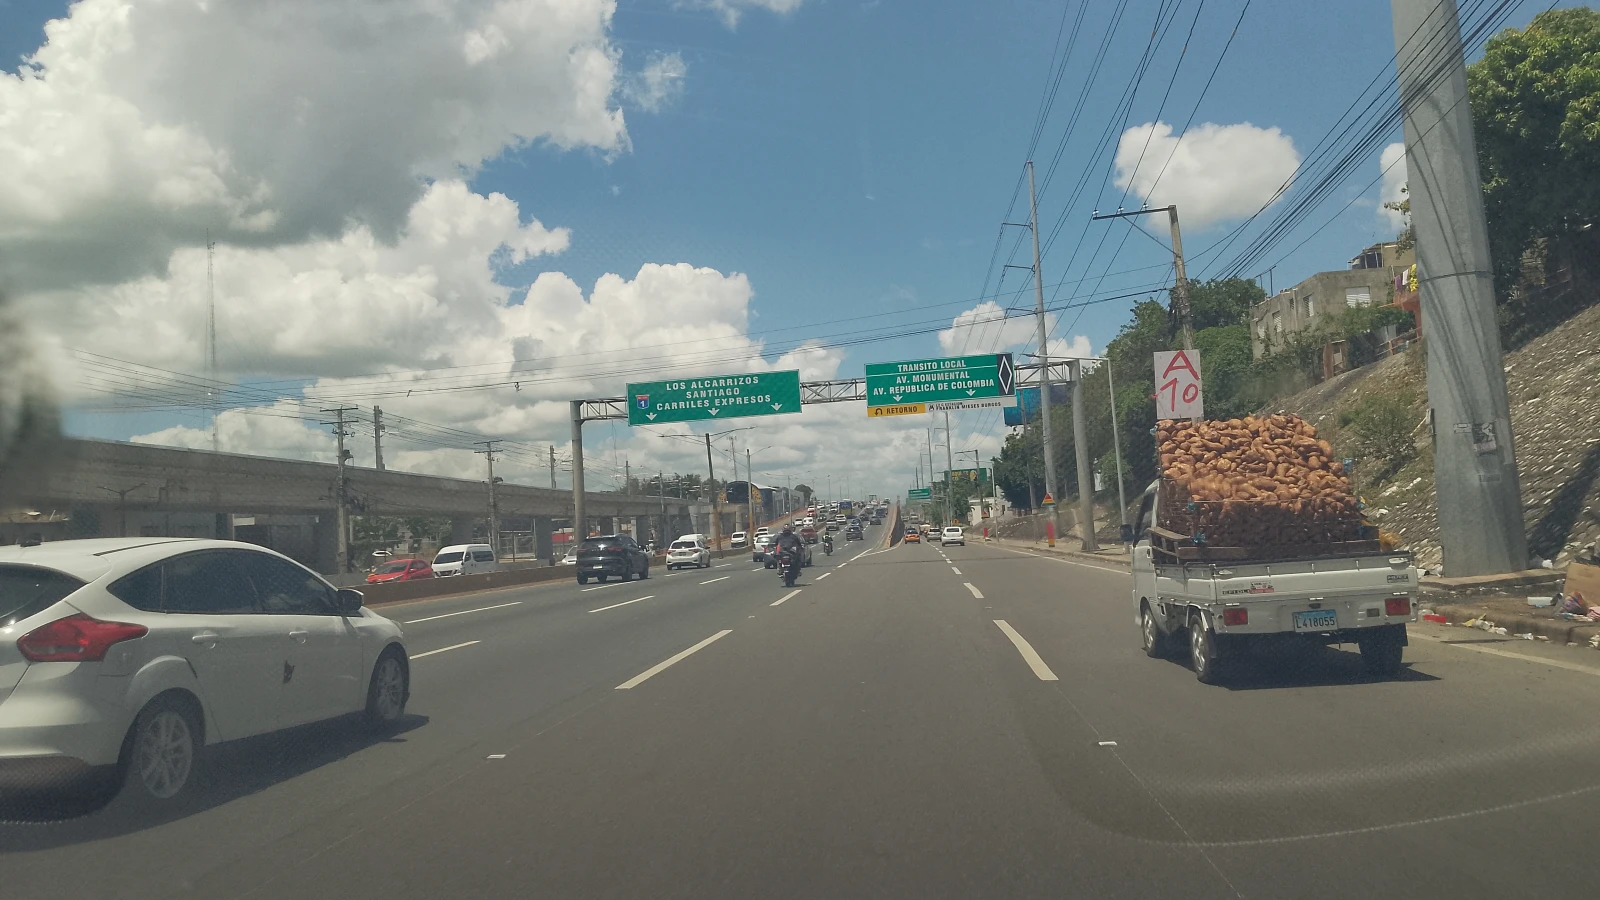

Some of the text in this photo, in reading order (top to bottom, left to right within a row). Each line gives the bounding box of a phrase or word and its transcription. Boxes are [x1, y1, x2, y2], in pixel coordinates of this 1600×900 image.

[897, 359, 967, 373] TRANSITO LOCAL
[1162, 350, 1200, 381] A
[666, 376, 759, 391] LOS ALCARRIZOS
[896, 370, 970, 384] AV. MONUMENTAL
[686, 387, 740, 399] SANTIAGO
[873, 378, 995, 396] AV. REPUBLICA DE COLOMBIA
[1158, 377, 1199, 412] 10
[639, 400, 645, 408] 1
[656, 394, 771, 411] CARRILES EXPRESOS
[886, 405, 918, 415] RETORNO
[1295, 615, 1336, 629] L418055
